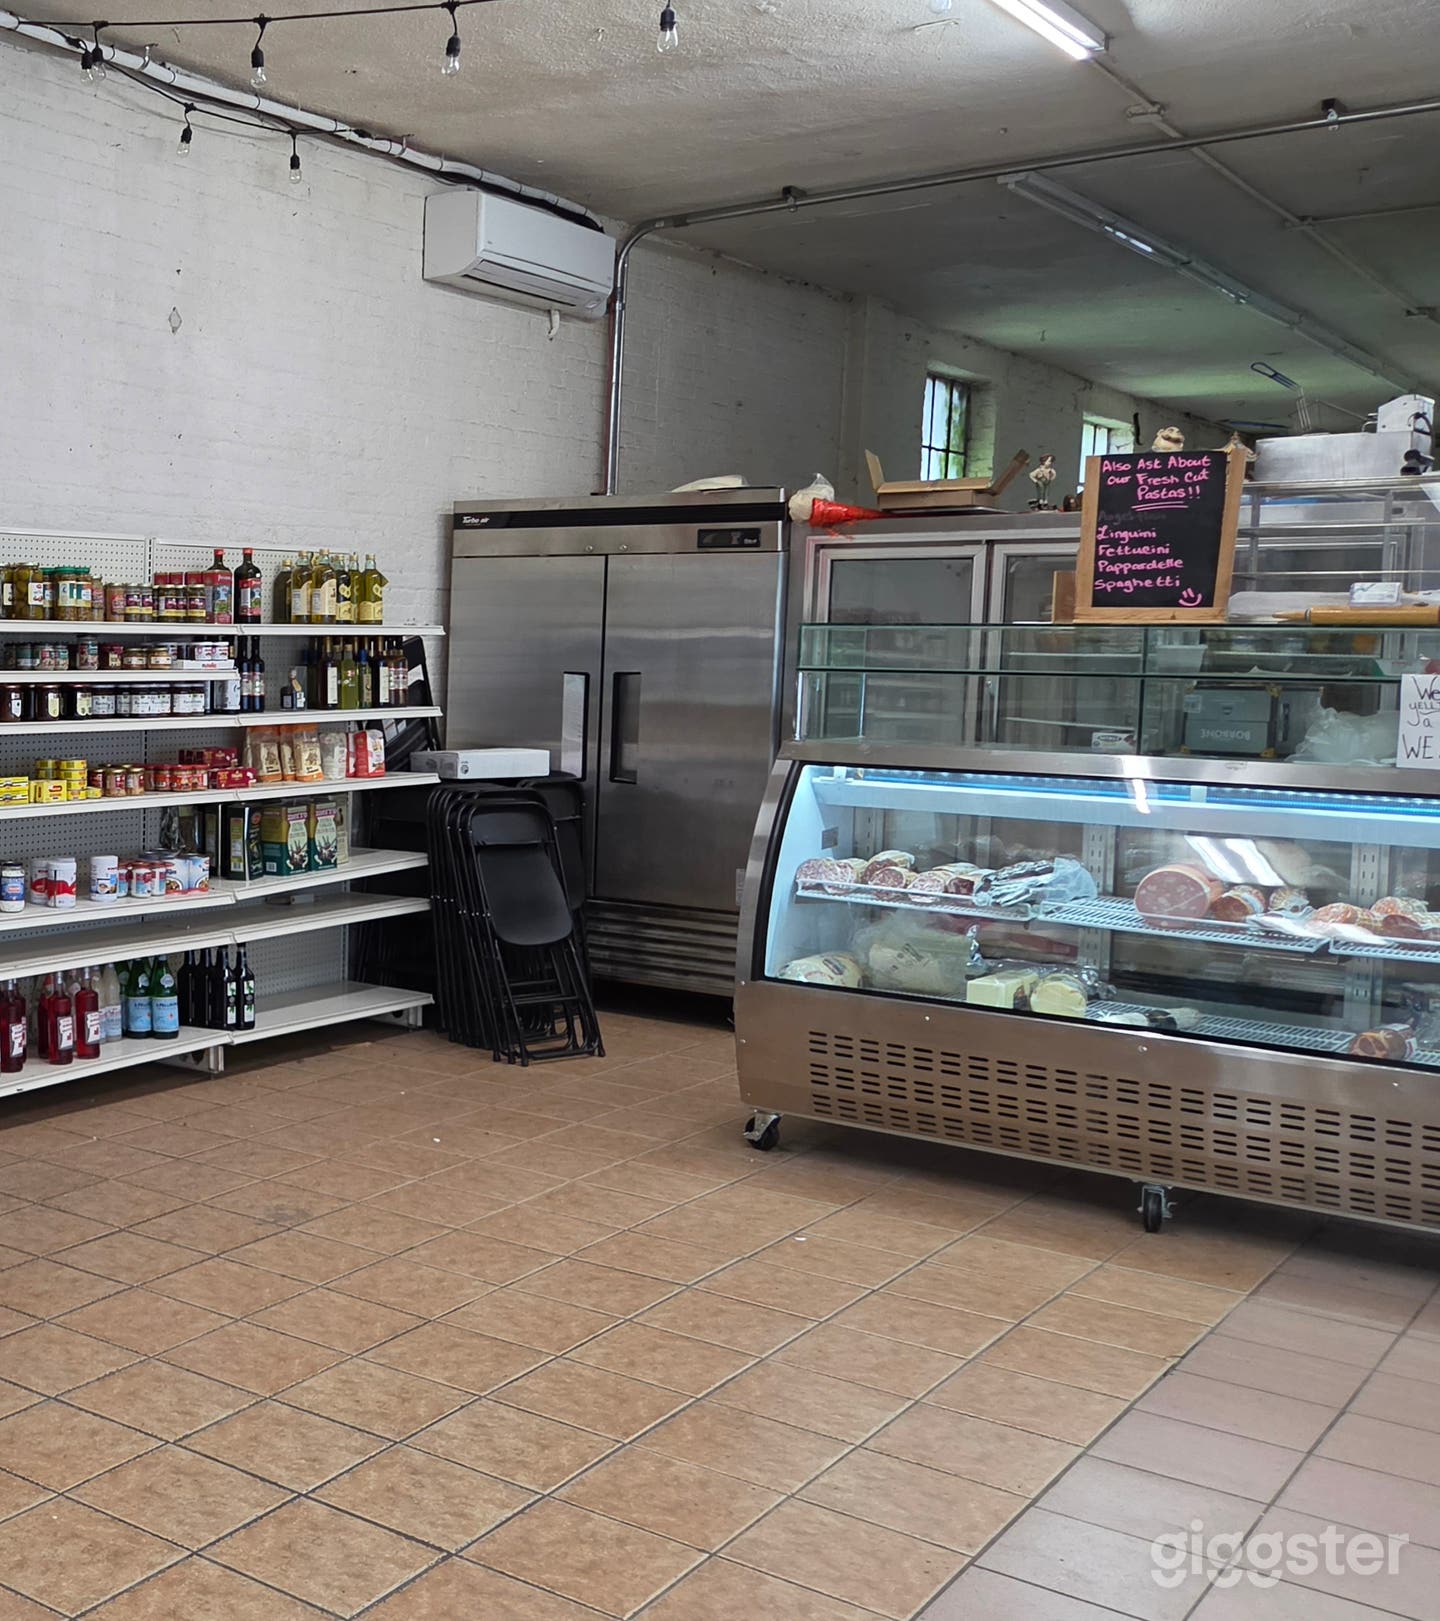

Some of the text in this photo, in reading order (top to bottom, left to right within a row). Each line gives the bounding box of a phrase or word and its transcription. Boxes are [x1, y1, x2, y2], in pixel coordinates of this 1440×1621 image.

[1102, 455, 1212, 473] Also Ask About
[1136, 472, 1180, 487] Fresh
[1184, 468, 1209, 483] Cut
[1136, 484, 1201, 501] Pastas!!
[1096, 525, 1158, 544] Linguini
[1098, 543, 1171, 557] Fettucini
[1097, 558, 1185, 576] Pappardelle
